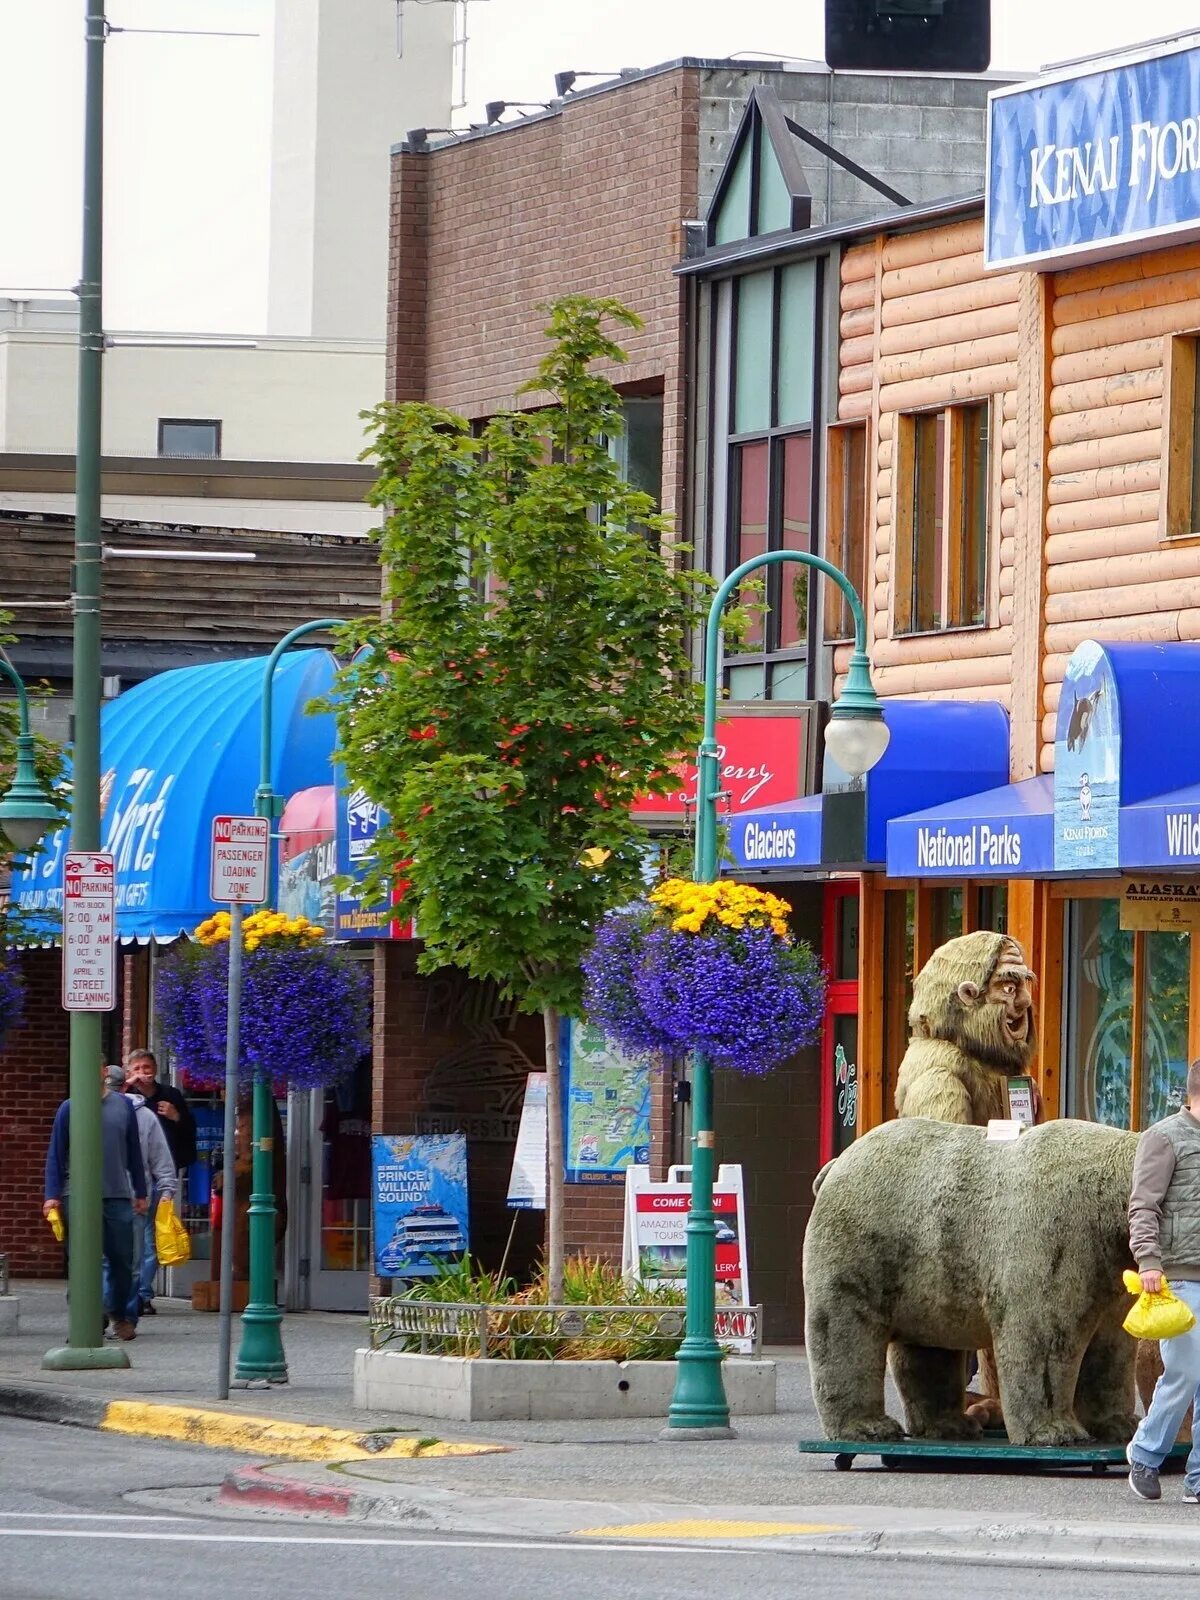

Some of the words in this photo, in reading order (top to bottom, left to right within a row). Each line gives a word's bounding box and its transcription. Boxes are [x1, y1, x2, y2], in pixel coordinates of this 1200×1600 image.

[1029, 135, 1119, 207] KENAI
[215, 822, 231, 838] NO
[231, 825, 266, 837] PARKING
[1063, 827, 1085, 841] KENAI
[744, 821, 796, 860] Glaciers
[917, 825, 976, 868] National
[980, 824, 1021, 866] Parks
[217, 849, 263, 861] PASSENGER
[222, 866, 257, 877] LOADING
[65, 879, 80, 895] NO
[81, 882, 113, 893] PARKING
[228, 882, 250, 893] ZONE
[68, 912, 90, 923] 2:00
[97, 913, 110, 923] AM
[85, 925, 93, 933] TO
[68, 934, 90, 944] 6:00
[97, 934, 110, 944] AM
[73, 967, 92, 976] APRIL
[97, 967, 105, 976] 15
[72, 979, 105, 989] STREET
[66, 992, 110, 1002] CLEANING
[377, 1170, 425, 1182] PRINCE
[377, 1181, 431, 1192] WILLIAM
[377, 1191, 422, 1203] SOUND
[652, 1198, 685, 1208] COME
[640, 1220, 684, 1229] AMAZING
[654, 1231, 685, 1240] TOURS
[714, 1263, 737, 1272] LERY
